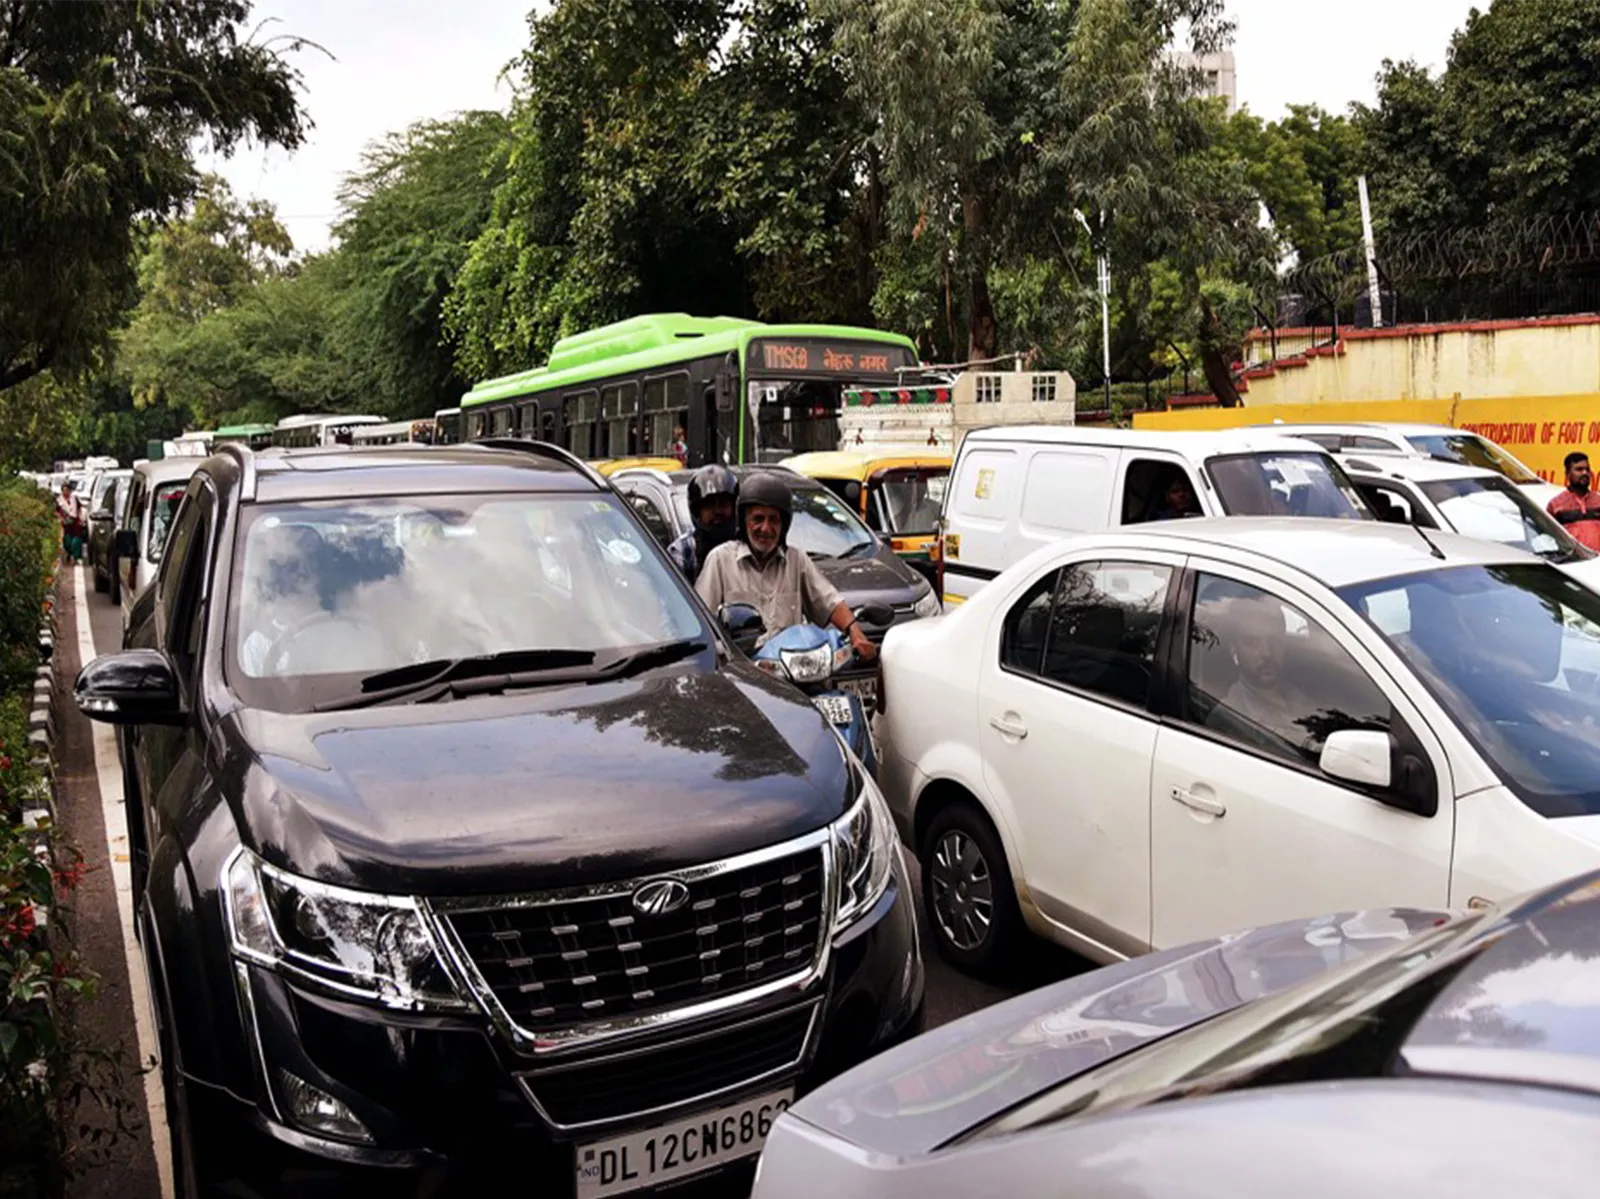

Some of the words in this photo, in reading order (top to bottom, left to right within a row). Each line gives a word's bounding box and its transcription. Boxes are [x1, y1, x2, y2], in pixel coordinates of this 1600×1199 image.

[1541, 422, 1556, 445] OF
[1557, 421, 1585, 445] FOOT
[580, 1165, 600, 1178] IND
